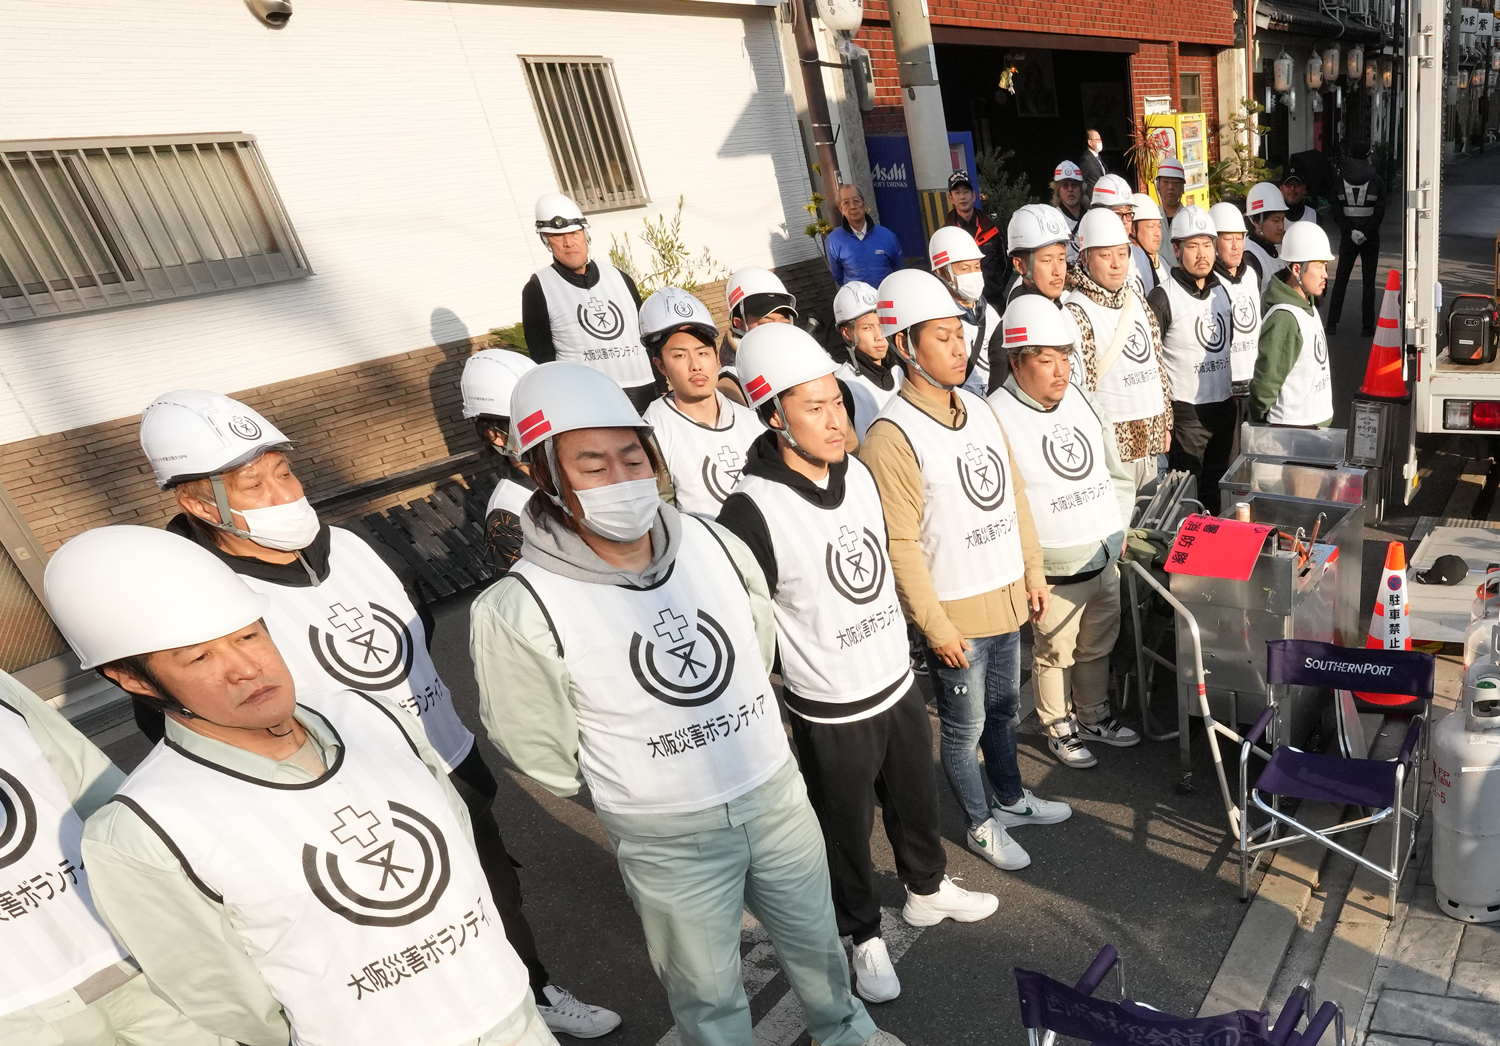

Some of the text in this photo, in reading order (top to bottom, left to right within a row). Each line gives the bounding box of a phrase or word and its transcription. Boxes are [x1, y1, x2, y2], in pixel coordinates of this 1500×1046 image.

[871, 163, 907, 182] Asahi
[1388, 594, 1401, 649] 駐車禁止
[1304, 657, 1393, 676] SOUTHERNPORT
[647, 694, 765, 759] 大阪災害ボランティア
